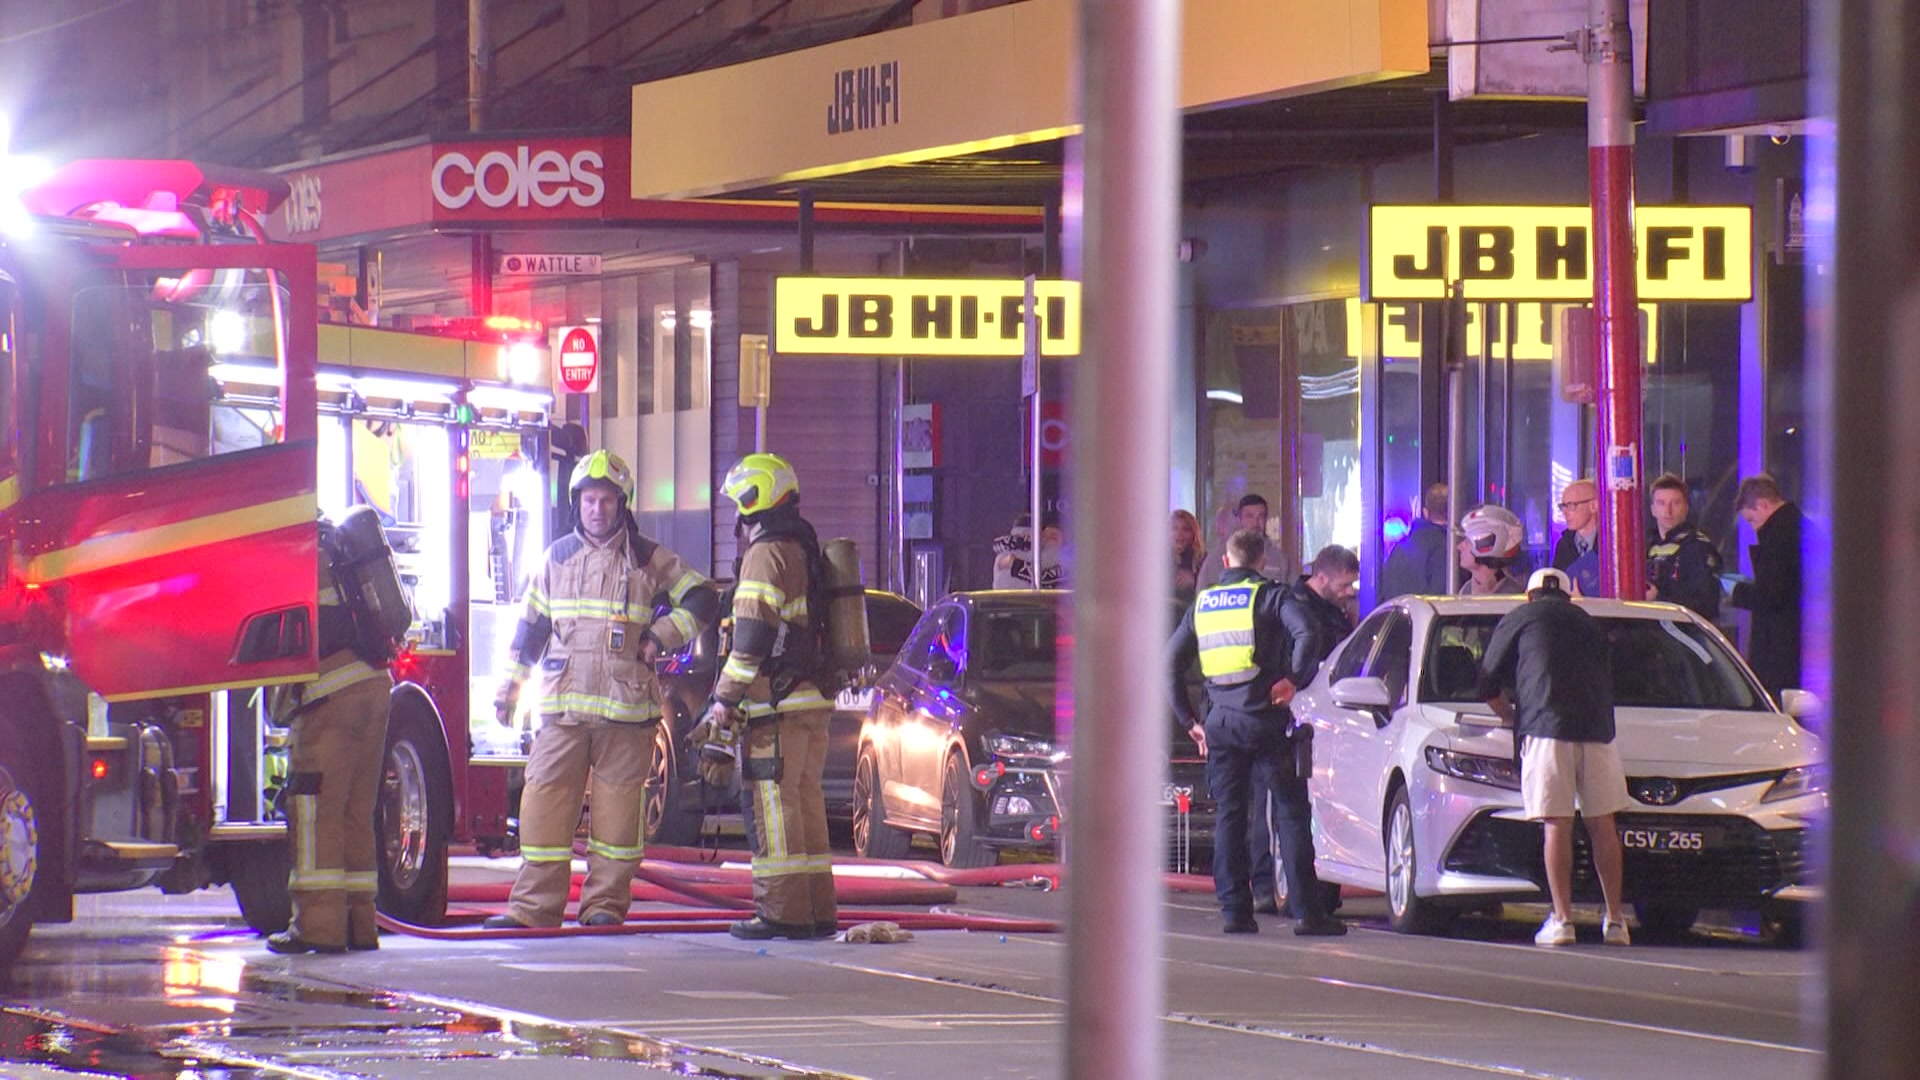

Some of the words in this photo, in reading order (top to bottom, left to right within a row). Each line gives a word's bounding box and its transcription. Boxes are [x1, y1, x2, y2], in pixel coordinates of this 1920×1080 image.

[828, 70, 854, 135] JB
[432, 146, 605, 209] coles
[1393, 225, 1515, 280] JB
[525, 256, 583, 273] WATTLE
[794, 293, 894, 339] JB
[572, 338, 586, 351] NO
[565, 368, 593, 381] ENTRY
[1199, 591, 1248, 610] Police
[1623, 830, 1657, 848] CSV
[1668, 831, 1702, 849] 265
